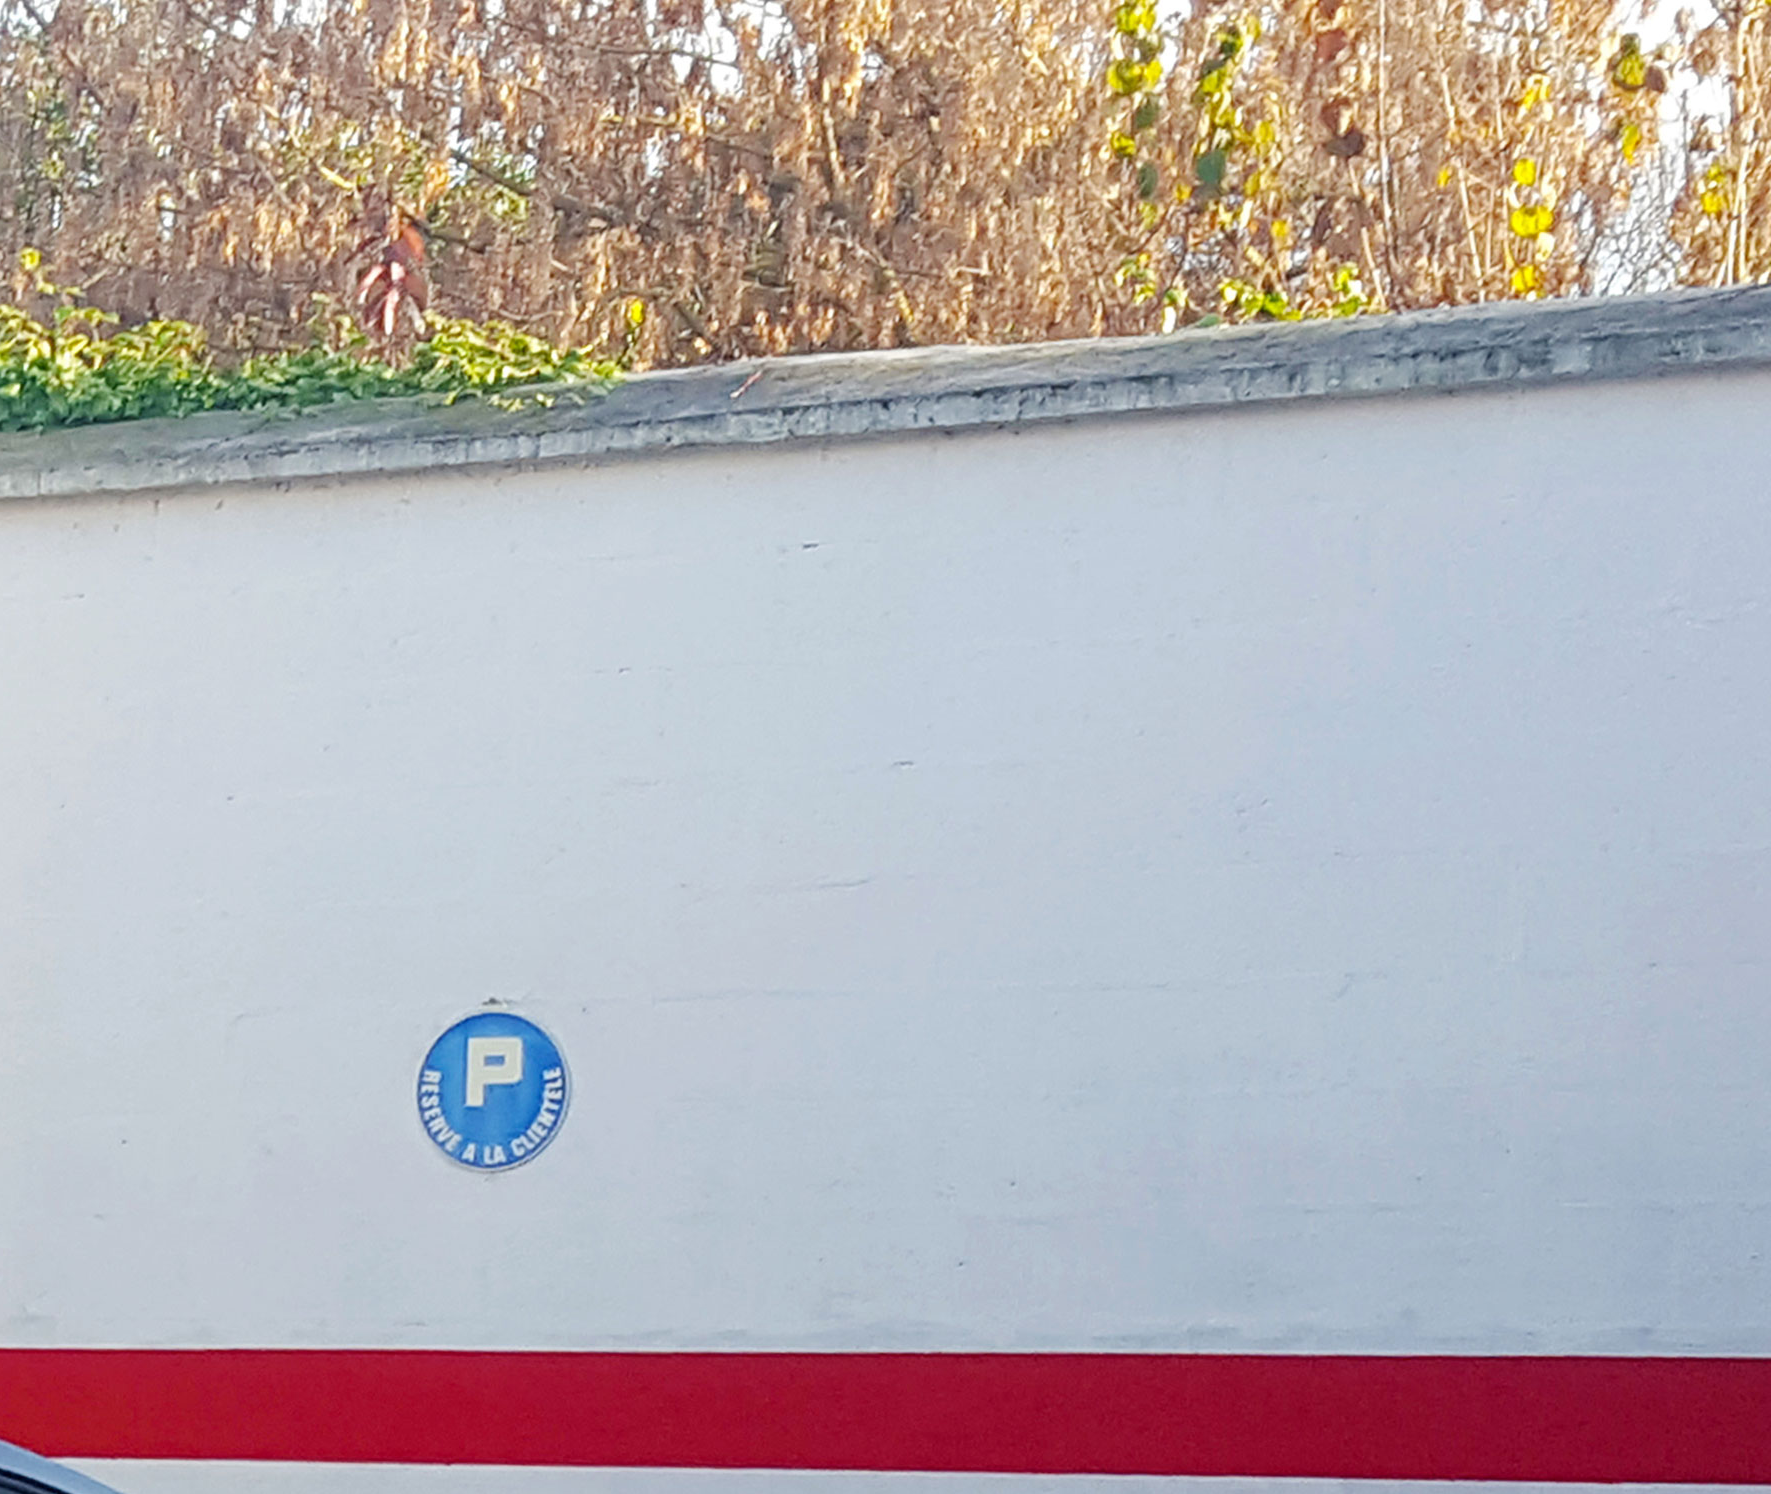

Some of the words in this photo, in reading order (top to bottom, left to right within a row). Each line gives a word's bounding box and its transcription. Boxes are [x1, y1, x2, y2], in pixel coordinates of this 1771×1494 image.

[465, 1036, 523, 1107] P
[421, 1069, 462, 1151] RESERVE
[483, 1145, 507, 1165] LA
[510, 1066, 563, 1157] CLIENTELE
